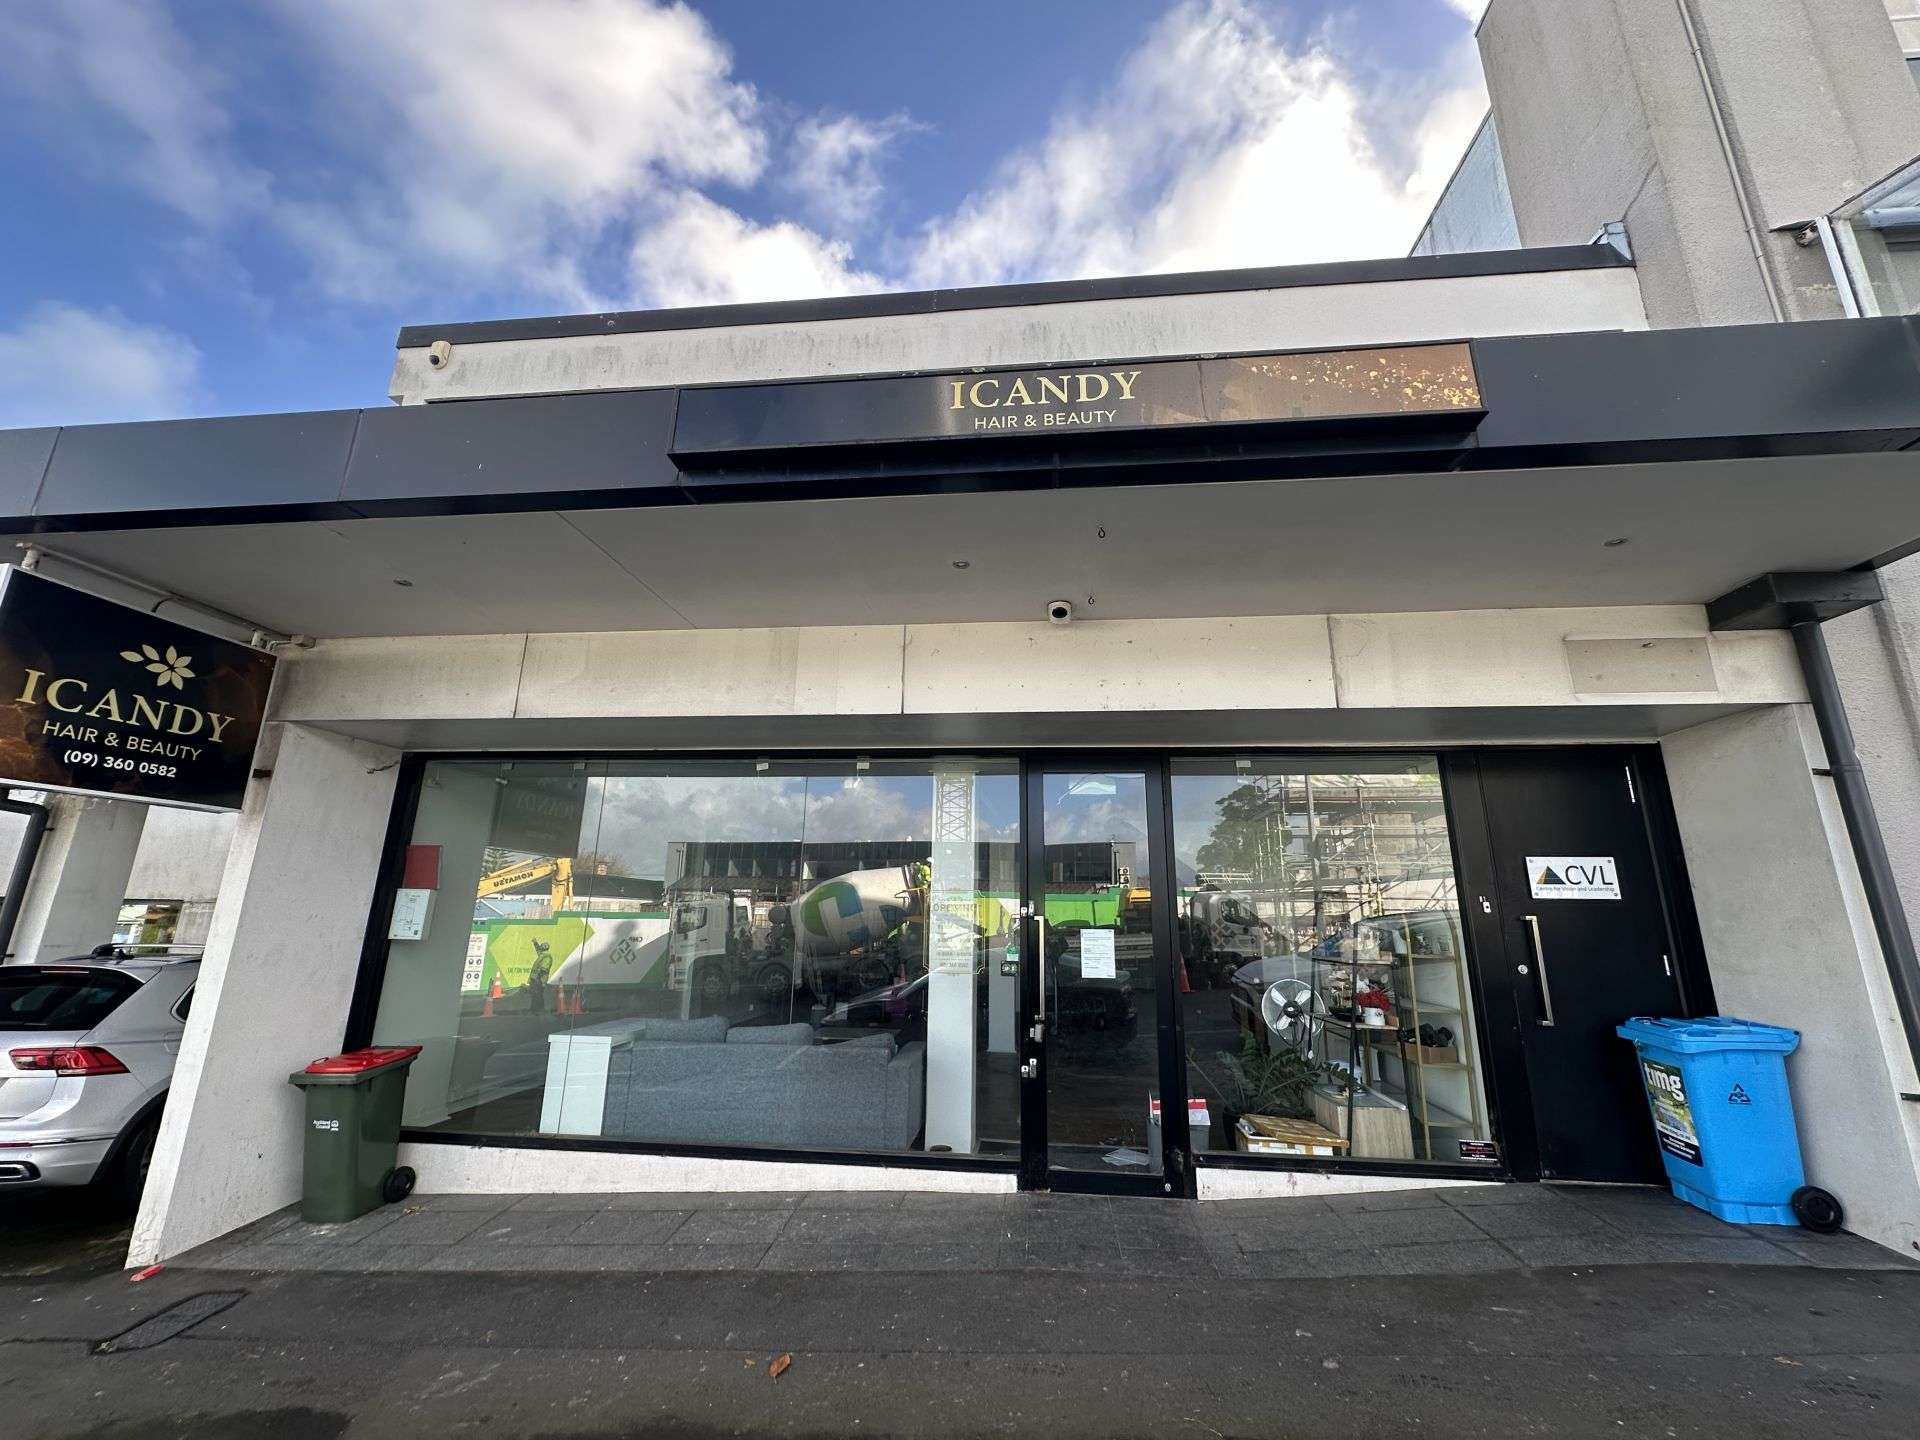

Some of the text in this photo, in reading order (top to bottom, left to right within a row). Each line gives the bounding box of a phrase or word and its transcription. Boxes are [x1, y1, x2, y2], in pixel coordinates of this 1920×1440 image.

[950, 371, 1142, 409] ICANDY
[974, 409, 1117, 430] HAIR & BEAUTY
[16, 668, 236, 743] ICANDY
[42, 719, 203, 761] HAIR & BEAUTY
[63, 749, 177, 778] (09) 360 0582
[1565, 865, 1614, 885] CVL
[1643, 1062, 1685, 1102] timg
